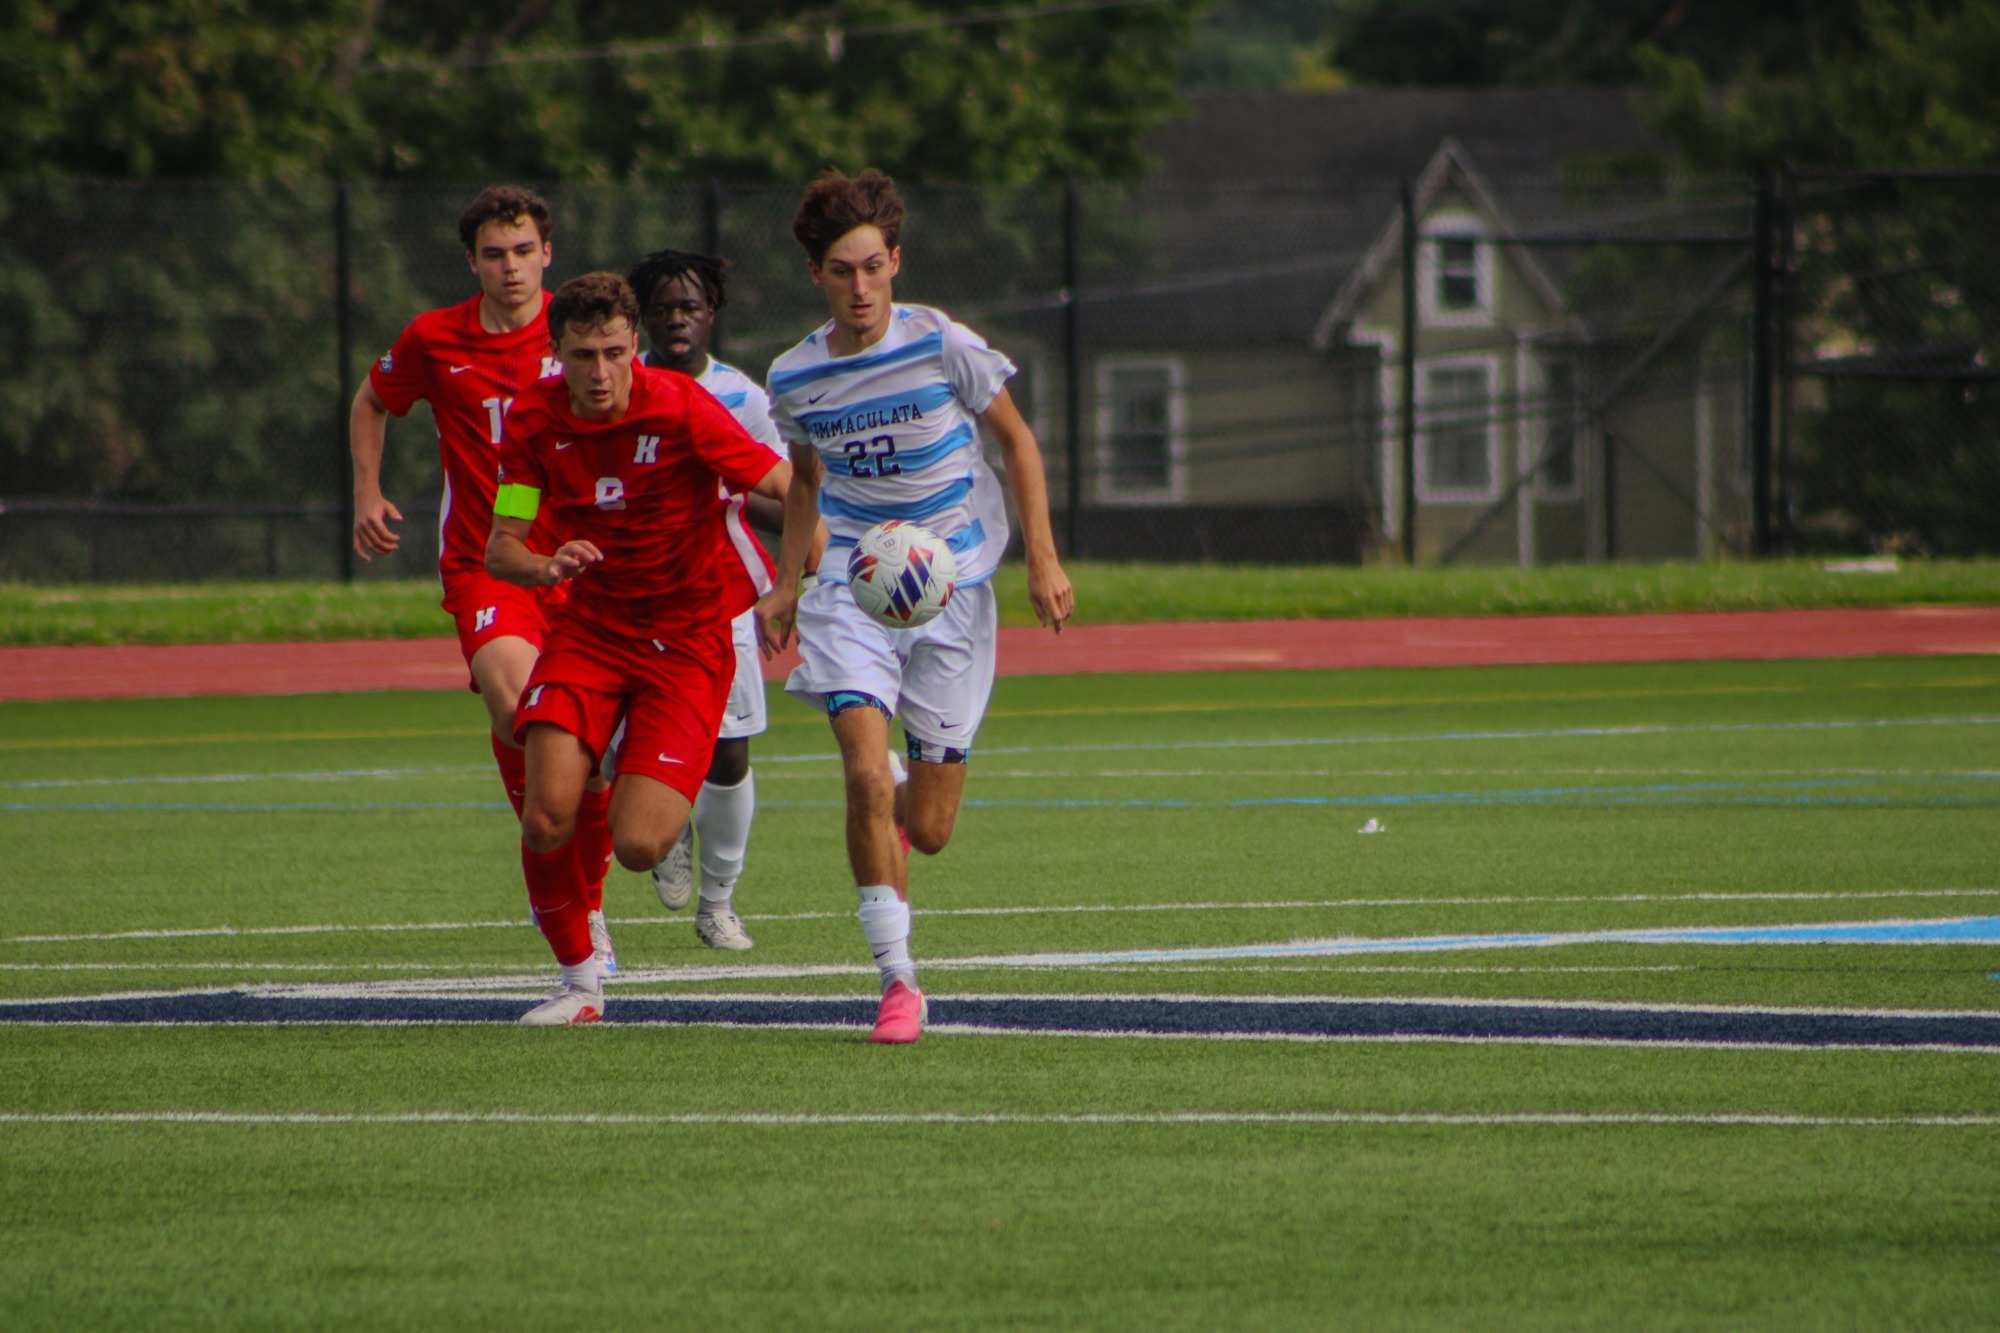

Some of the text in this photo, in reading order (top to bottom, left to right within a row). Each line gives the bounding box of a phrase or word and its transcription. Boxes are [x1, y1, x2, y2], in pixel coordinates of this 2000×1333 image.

[482, 397, 513, 444] 1
[813, 403, 923, 438] IMMACULATA
[633, 434, 660, 463] H
[844, 435, 902, 478] 22
[474, 606, 496, 632] H
